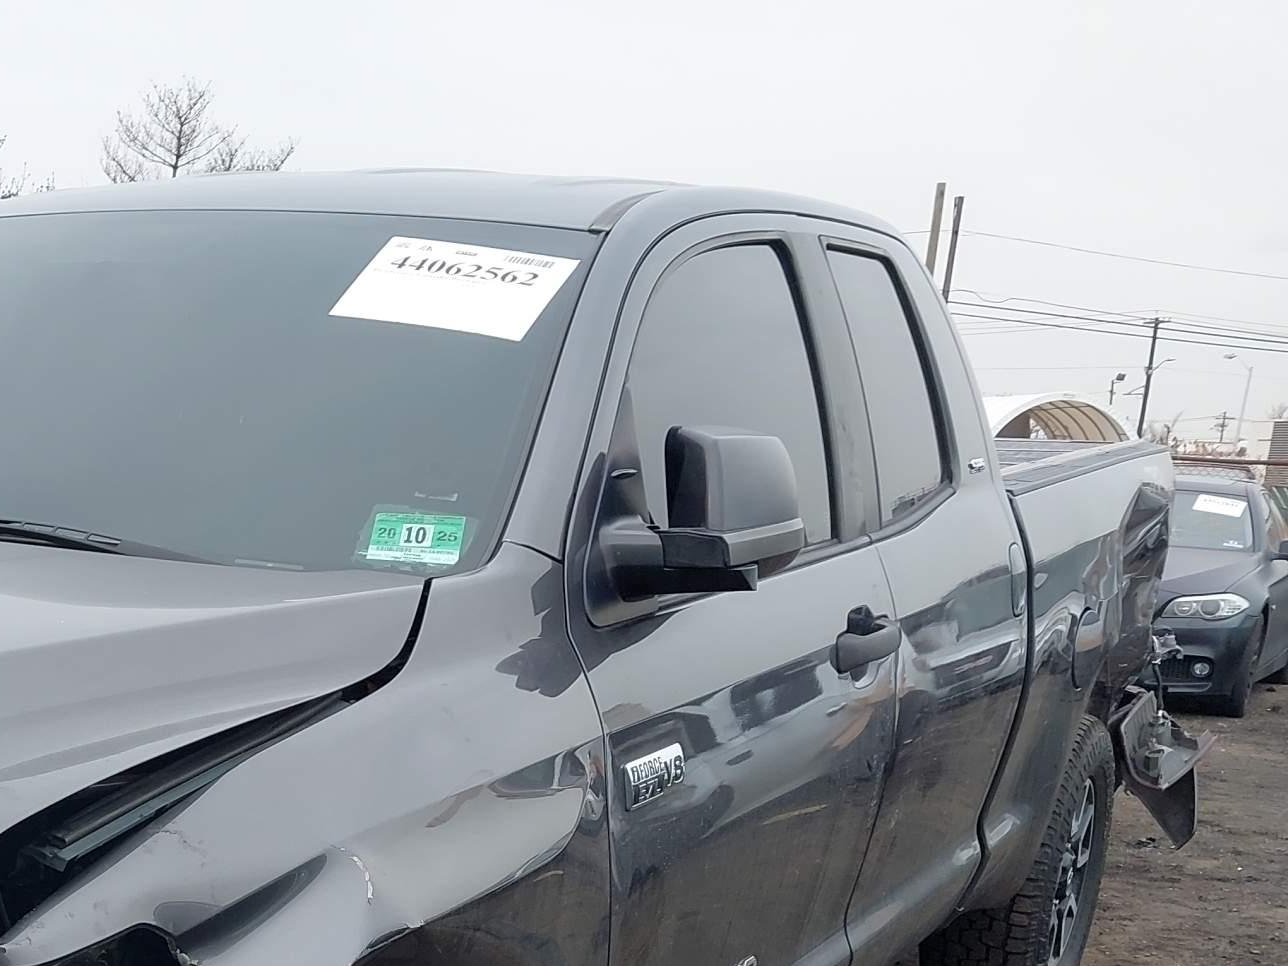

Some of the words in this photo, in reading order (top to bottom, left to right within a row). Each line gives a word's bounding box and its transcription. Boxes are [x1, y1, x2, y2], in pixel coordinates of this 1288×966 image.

[390, 255, 539, 286] 44062562
[377, 527, 397, 539] 20
[403, 526, 427, 545] 10
[437, 531, 458, 543] 25
